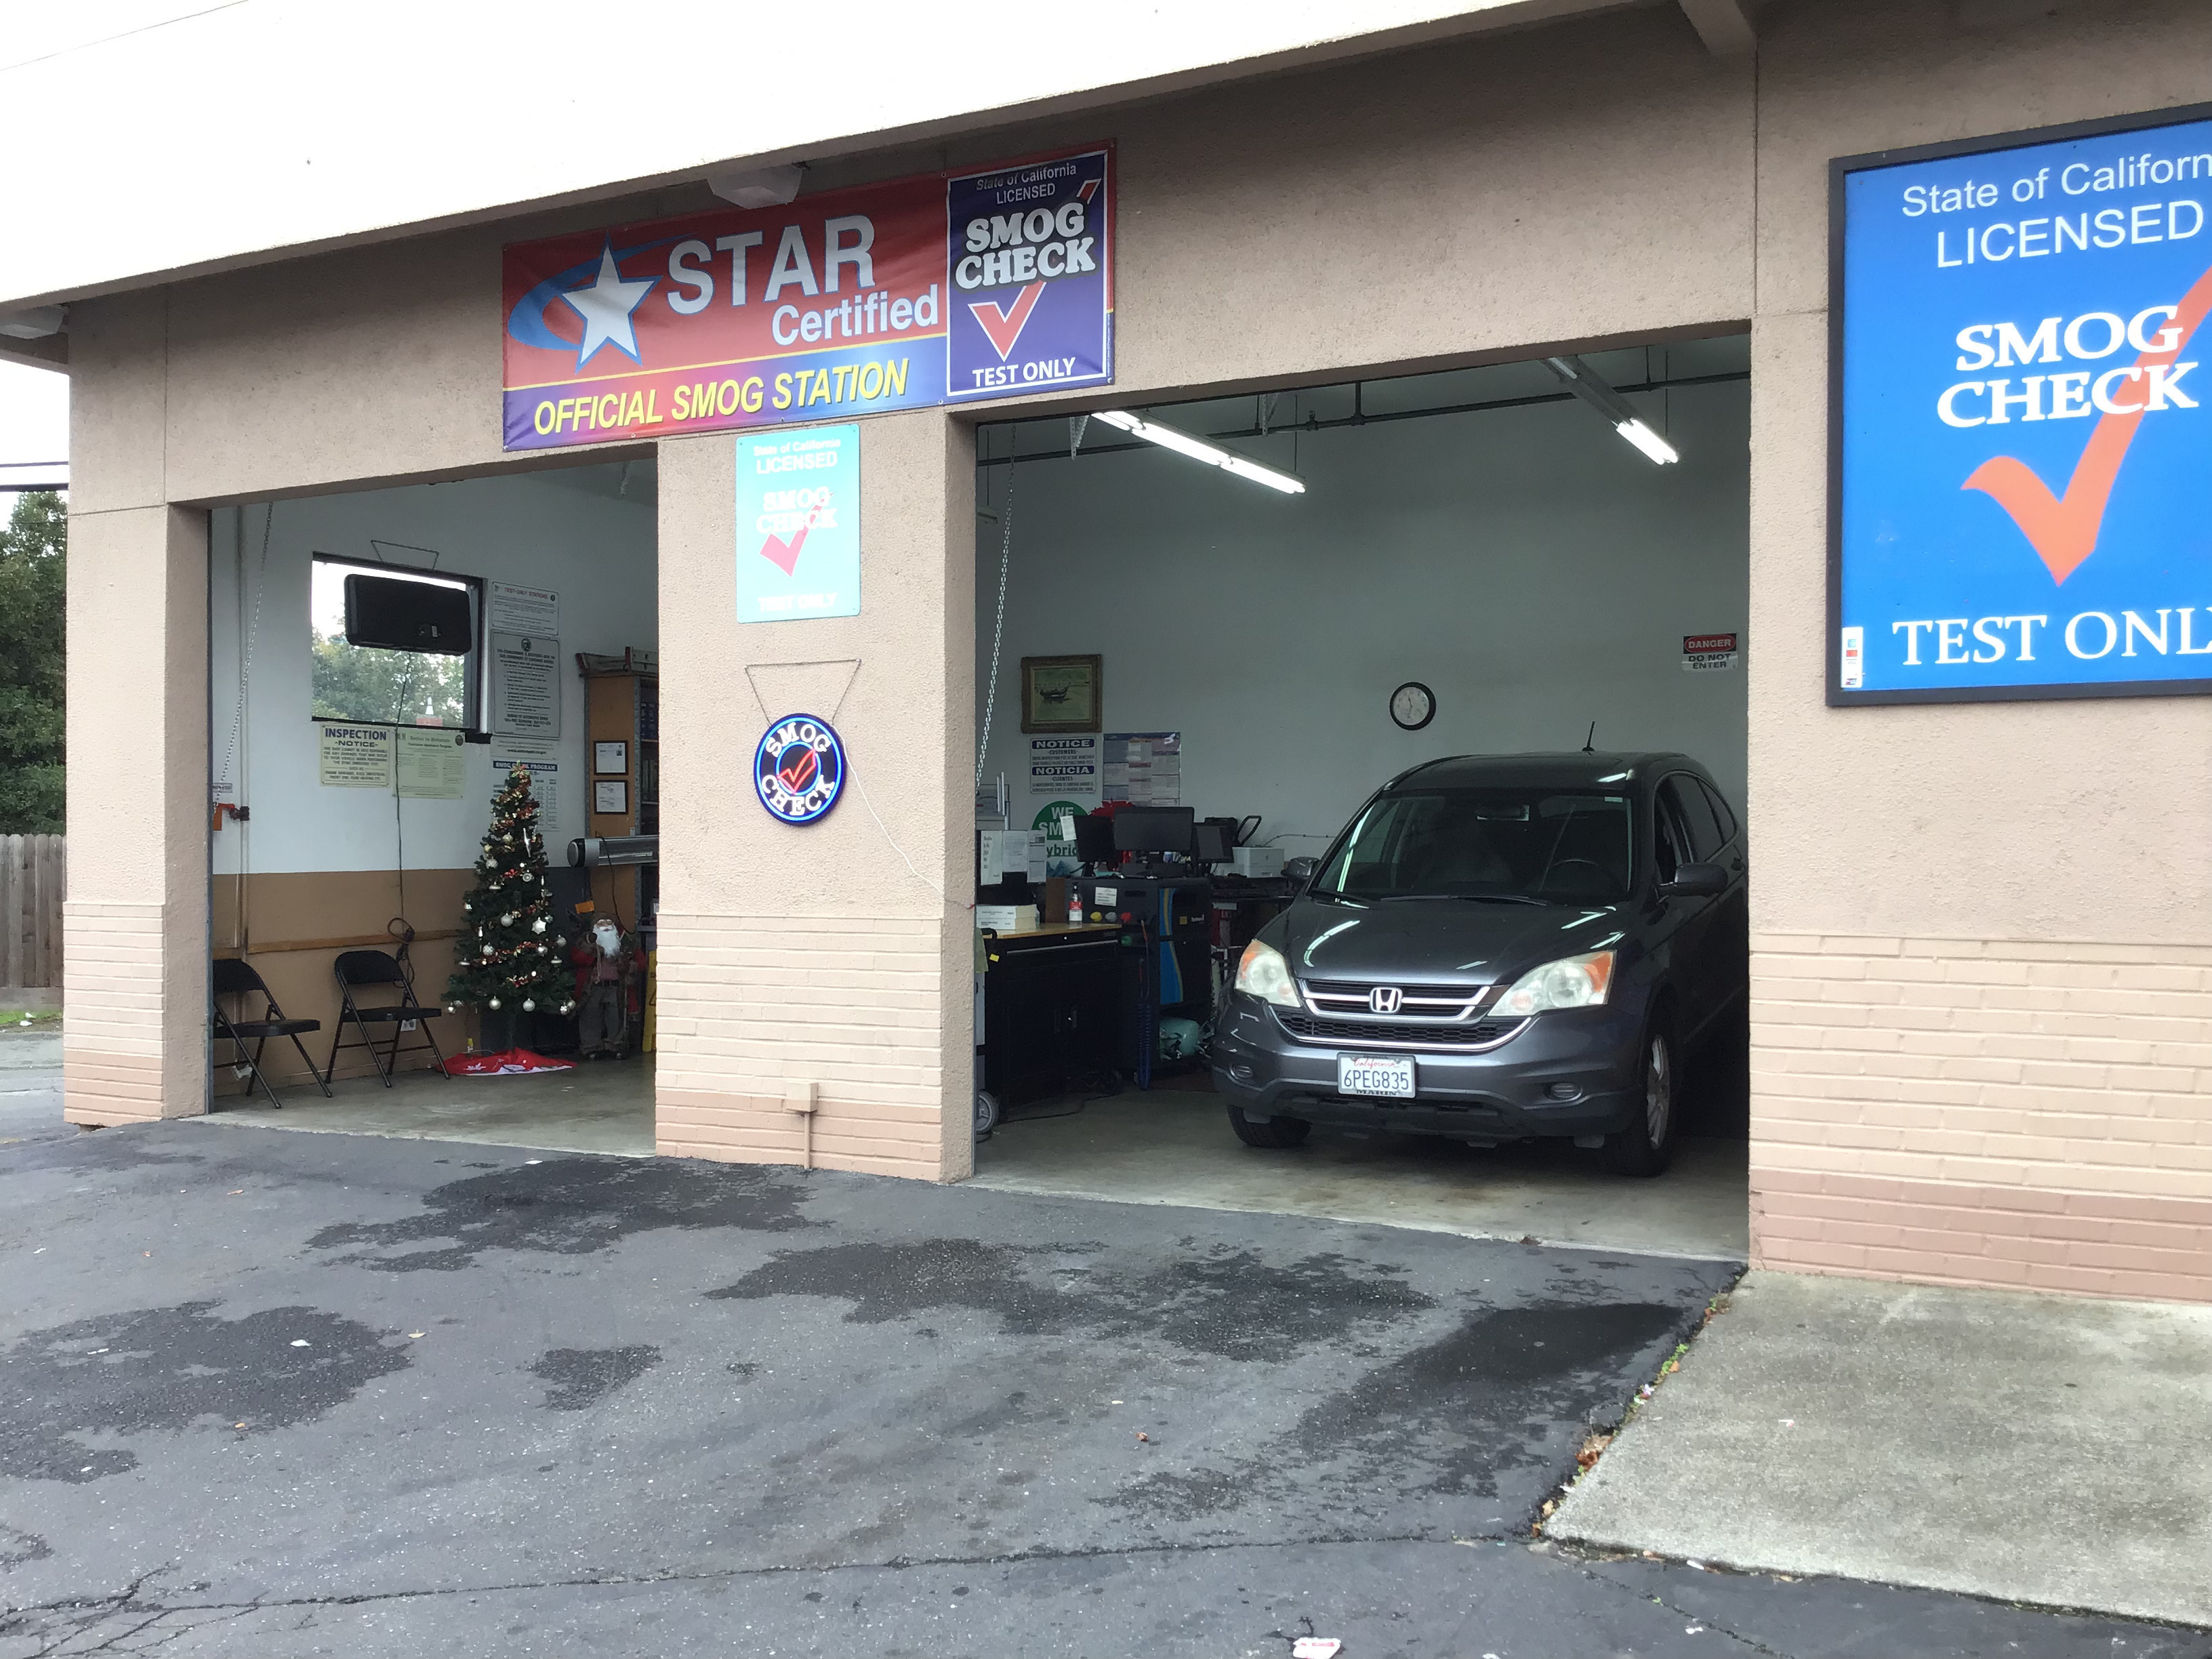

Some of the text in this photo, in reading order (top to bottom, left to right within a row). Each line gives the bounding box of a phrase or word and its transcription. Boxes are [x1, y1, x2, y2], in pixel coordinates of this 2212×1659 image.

[976, 163, 1076, 191] State of California
[1902, 180, 1999, 217] State
[2012, 167, 2050, 203] of
[996, 183, 1056, 204] LICENSED
[966, 202, 1084, 252] SMOG
[1937, 200, 2204, 268] LICENSED
[666, 214, 876, 317] STAR
[956, 237, 1096, 289] CHECK
[771, 284, 940, 346] Certified
[1956, 304, 2184, 371] SMOG
[972, 356, 1076, 388] TEST ONLY
[534, 359, 909, 436] OFFICIAL SMOG STATION
[1937, 361, 2199, 428] CHECK
[781, 441, 791, 453] of
[793, 438, 841, 452] California
[756, 451, 838, 474] LICENSED
[763, 487, 831, 512] SMOG
[756, 508, 839, 534] CHECK
[1688, 639, 1731, 649] DANGER
[1891, 607, 2212, 666] TEST ONL
[325, 728, 387, 741] INSPECTION
[766, 722, 832, 758] SMOG
[1036, 739, 1090, 748] NOTICE
[1036, 766, 1090, 775] NOTICIA
[762, 774, 835, 816] CHECK
[1039, 822, 1062, 836] SM
[1354, 1058, 1399, 1069] California
[1344, 1070, 1409, 1090] 6PEG835
